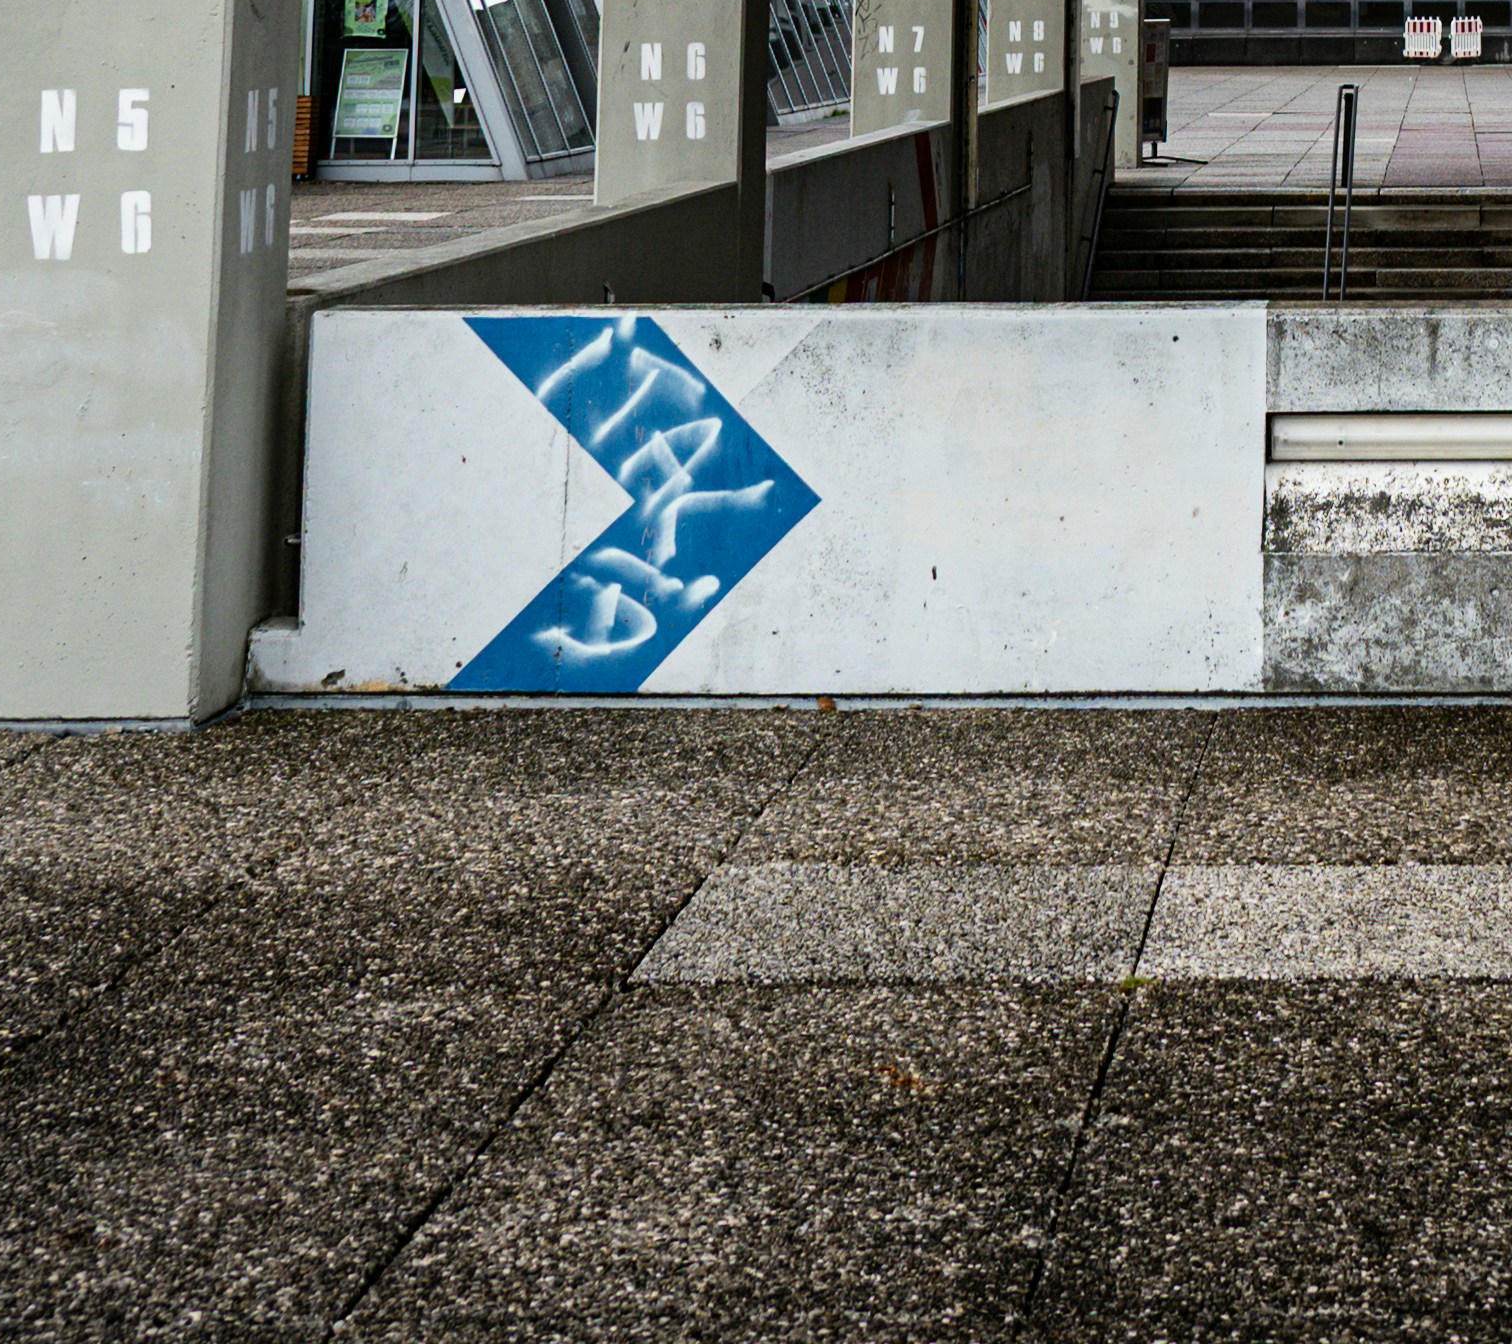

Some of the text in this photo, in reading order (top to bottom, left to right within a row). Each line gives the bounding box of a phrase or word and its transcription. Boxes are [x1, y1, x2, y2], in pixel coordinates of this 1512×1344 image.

[1010, 21, 1044, 41] N 8
[1091, 11, 1118, 28] N 9
[879, 26, 894, 53] N
[912, 26, 924, 52] 7
[1090, 37, 1103, 54] W
[641, 43, 705, 80] N 6
[1006, 53, 1044, 74] W 6
[877, 67, 926, 94] W 6
[40, 89, 149, 153] N 5
[245, 90, 259, 153] N
[267, 88, 277, 149] 5
[634, 102, 705, 140] W 6
[28, 191, 151, 260] W 6
[240, 184, 275, 254] W 6
